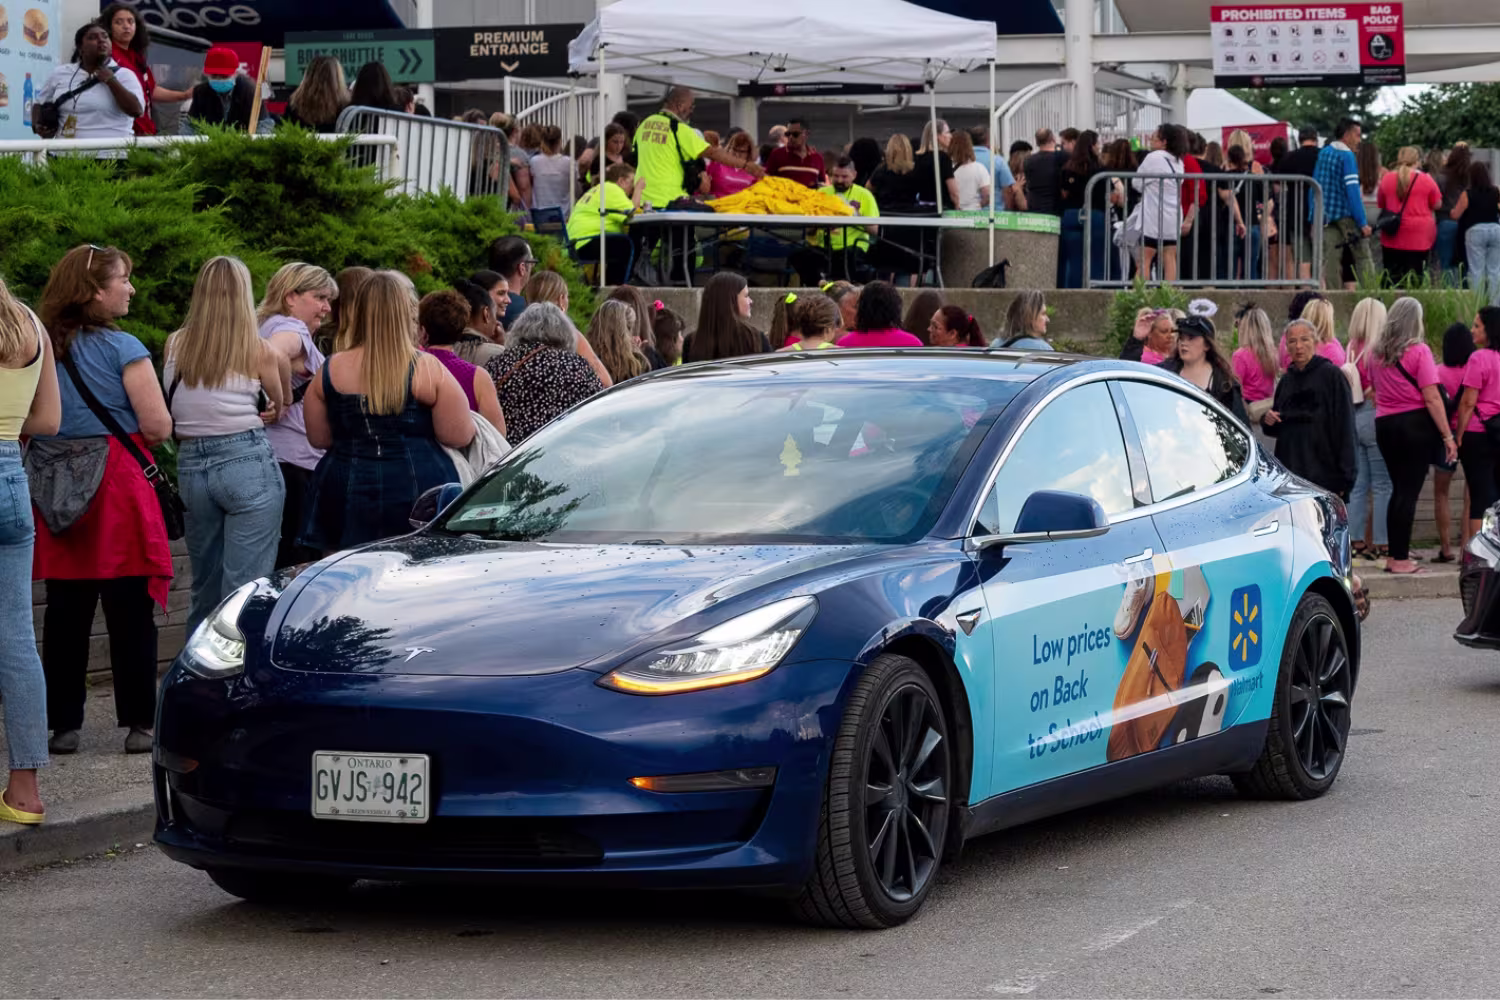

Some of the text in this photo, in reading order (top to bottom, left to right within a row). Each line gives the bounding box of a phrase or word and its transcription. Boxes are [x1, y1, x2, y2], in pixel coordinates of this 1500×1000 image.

[1221, 7, 1347, 21] PROHIBITED ITEMS
[1370, 6, 1391, 15] BAG
[1363, 15, 1399, 25] POLICY
[474, 31, 544, 43] PREMIUM
[332, 47, 385, 64] SHUTTLE
[470, 43, 549, 56] ENTRANCE
[1033, 623, 1111, 666] Low prices
[1030, 670, 1089, 712] on Back
[1231, 671, 1264, 697] Walmart
[1028, 711, 1103, 760] to School
[347, 757, 393, 769] ONTARIO
[317, 769, 422, 805] GVJS 942
